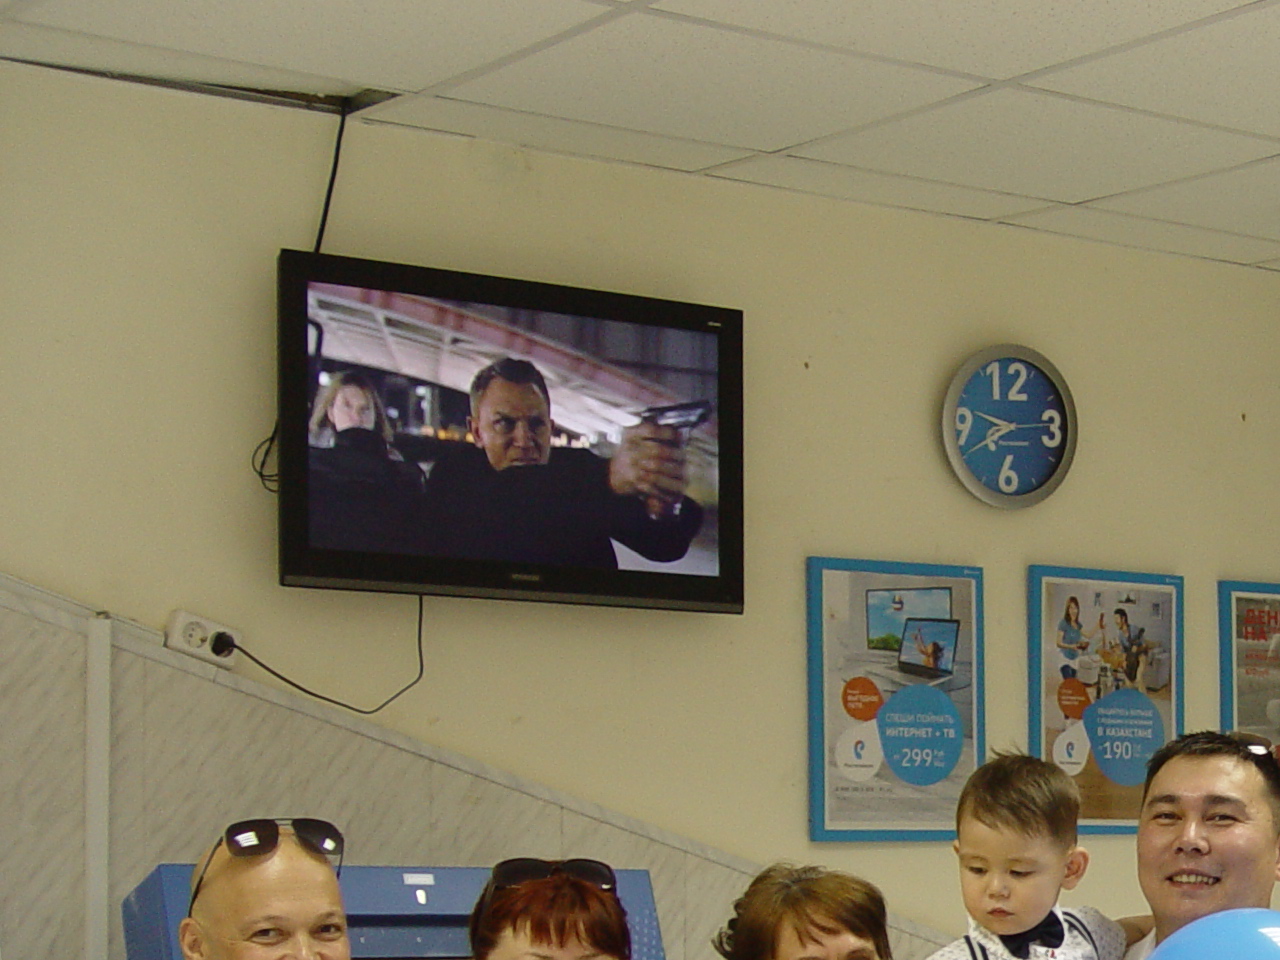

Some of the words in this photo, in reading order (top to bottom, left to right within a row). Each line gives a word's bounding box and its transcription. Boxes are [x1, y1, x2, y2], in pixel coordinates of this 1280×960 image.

[986, 361, 1028, 401] 12
[955, 406, 973, 446] 9
[1041, 409, 1062, 448] 3
[998, 455, 1018, 493] 6
[885, 727, 933, 738] ИНТЕРНЕТ
[1103, 741, 1132, 760] 190
[901, 748, 933, 767] 299
